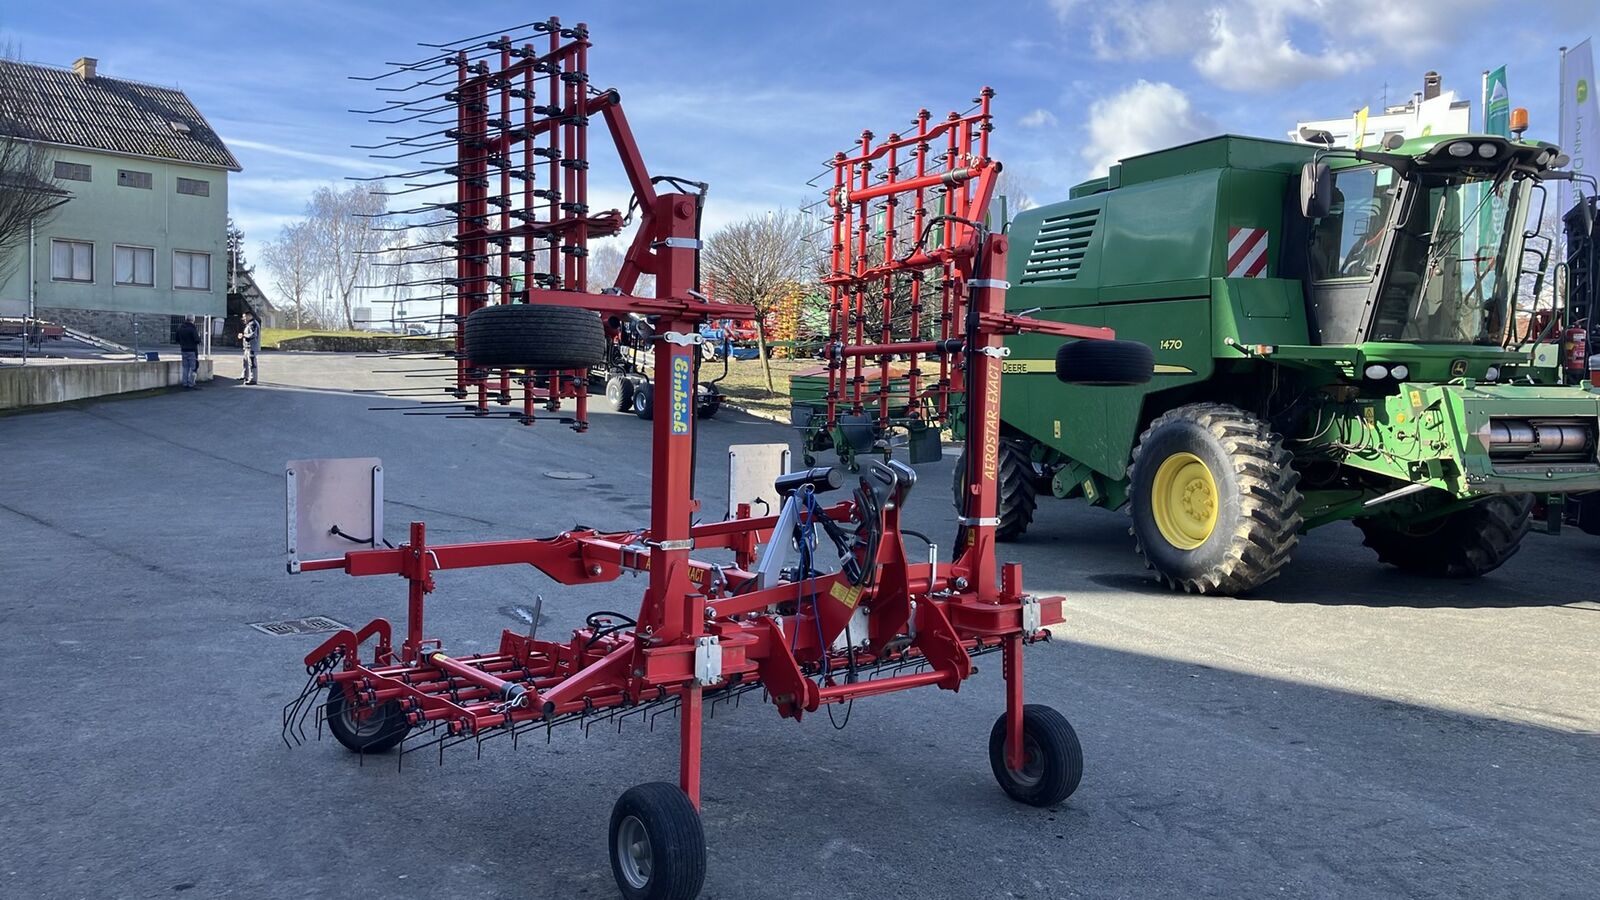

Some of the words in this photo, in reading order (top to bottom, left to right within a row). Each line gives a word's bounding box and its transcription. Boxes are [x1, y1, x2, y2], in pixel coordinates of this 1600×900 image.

[1160, 339, 1183, 350] 1470
[1002, 361, 1028, 372] DEERE
[674, 358, 688, 432] Einböck
[985, 363, 999, 480] AEROSTAR-EXACT
